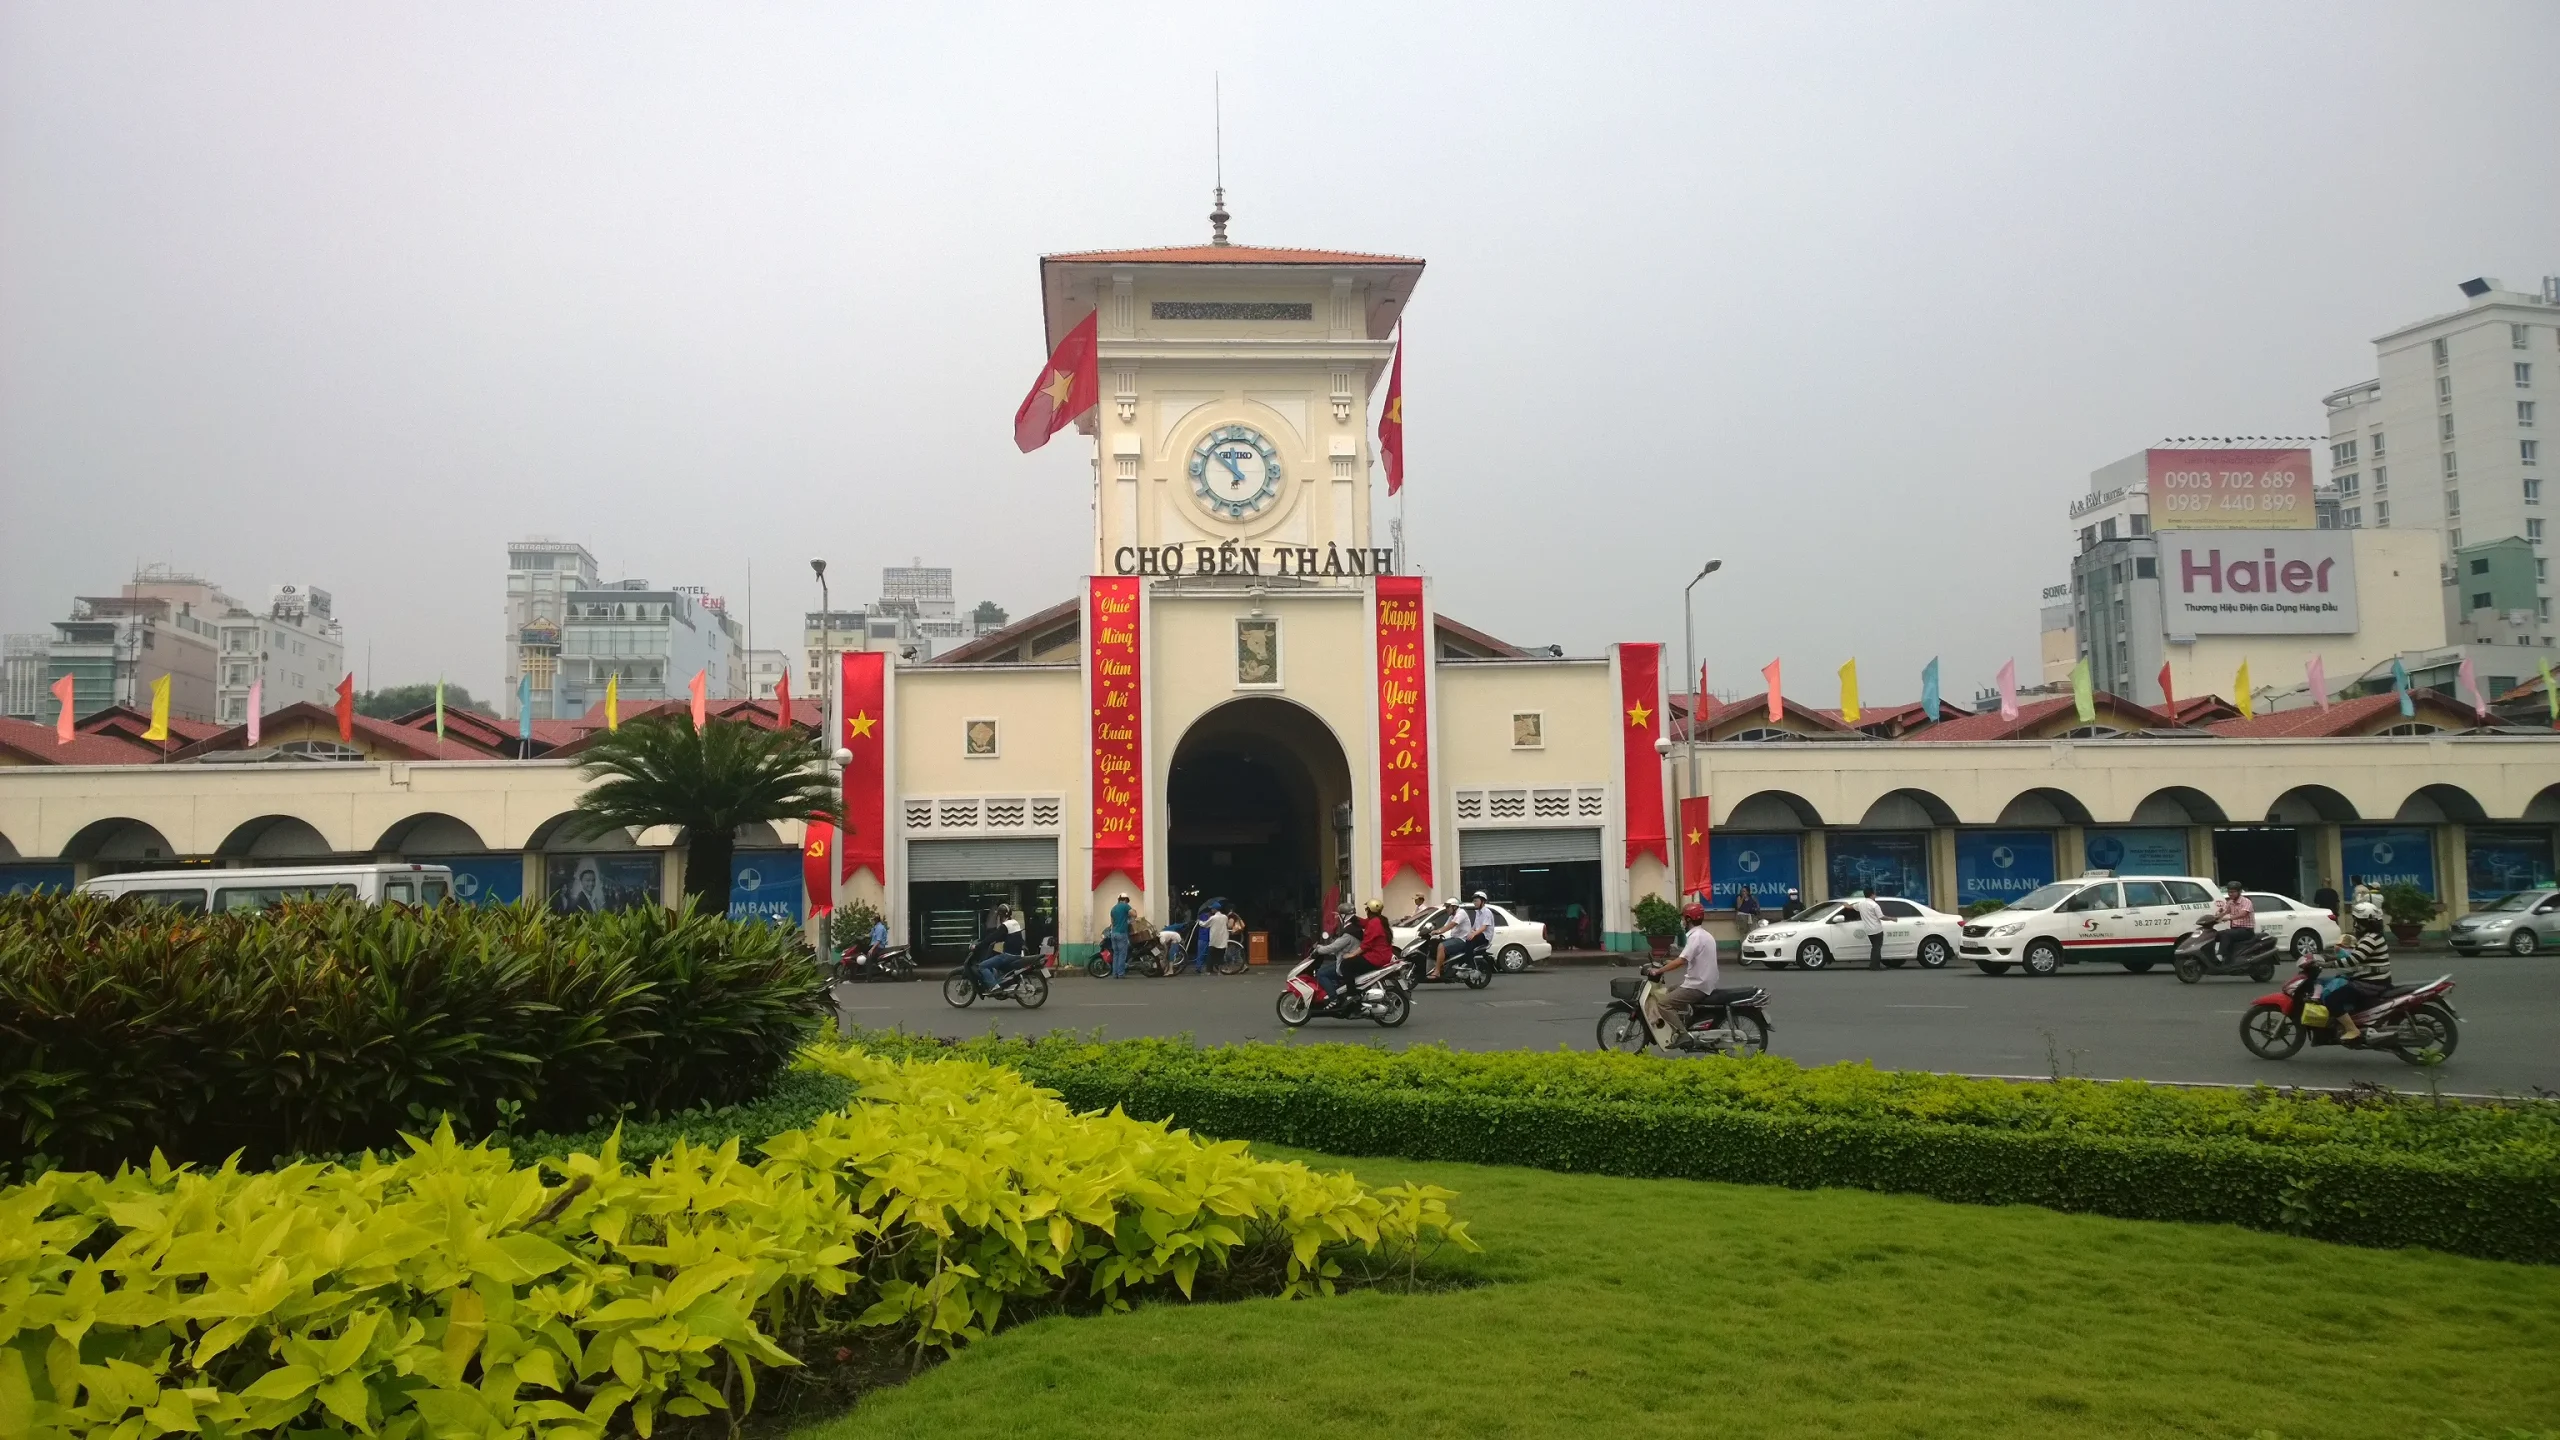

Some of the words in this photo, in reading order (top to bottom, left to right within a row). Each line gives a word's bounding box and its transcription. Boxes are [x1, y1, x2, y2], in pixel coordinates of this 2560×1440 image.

[1227, 427, 1244, 439] 12
[1189, 461, 1202, 476] 9
[2165, 471, 2212, 489] 0903
[2219, 471, 2254, 488] 702
[2260, 471, 2296, 488] 689
[1229, 502, 1241, 516] 6
[2069, 500, 2078, 516] A
[2085, 490, 2102, 509] EM
[2166, 494, 2212, 511] 0987
[2219, 494, 2255, 511] 440
[2262, 494, 2296, 511] 899
[508, 543, 546, 551] CENTRAL
[1114, 543, 1183, 579] CHỢ
[1196, 537, 1260, 576] BẾN
[1273, 540, 1394, 576] THÀNH
[2181, 548, 2336, 593] Haier
[672, 586, 706, 595] HOTEL
[2042, 584, 2067, 599] SONG
[1101, 596, 1130, 613] Chúc
[2219, 603, 2238, 612] Hiệu
[2261, 604, 2274, 612] Gia
[2300, 603, 2320, 613] Hàng
[1380, 600, 1417, 631] Happy
[1097, 627, 1132, 647] Mừng
[1383, 645, 1416, 668] New
[1100, 658, 1132, 675] Năm
[1103, 691, 1128, 708] Mới
[1383, 680, 1418, 710] Year
[1098, 722, 1133, 740] Xuân
[1100, 754, 1132, 776] Giáp
[1103, 786, 1130, 807] Ngọ
[1102, 817, 1133, 832] 2014
[1967, 878, 2041, 890] EXIMBANK
[729, 902, 789, 914] IMBANK
